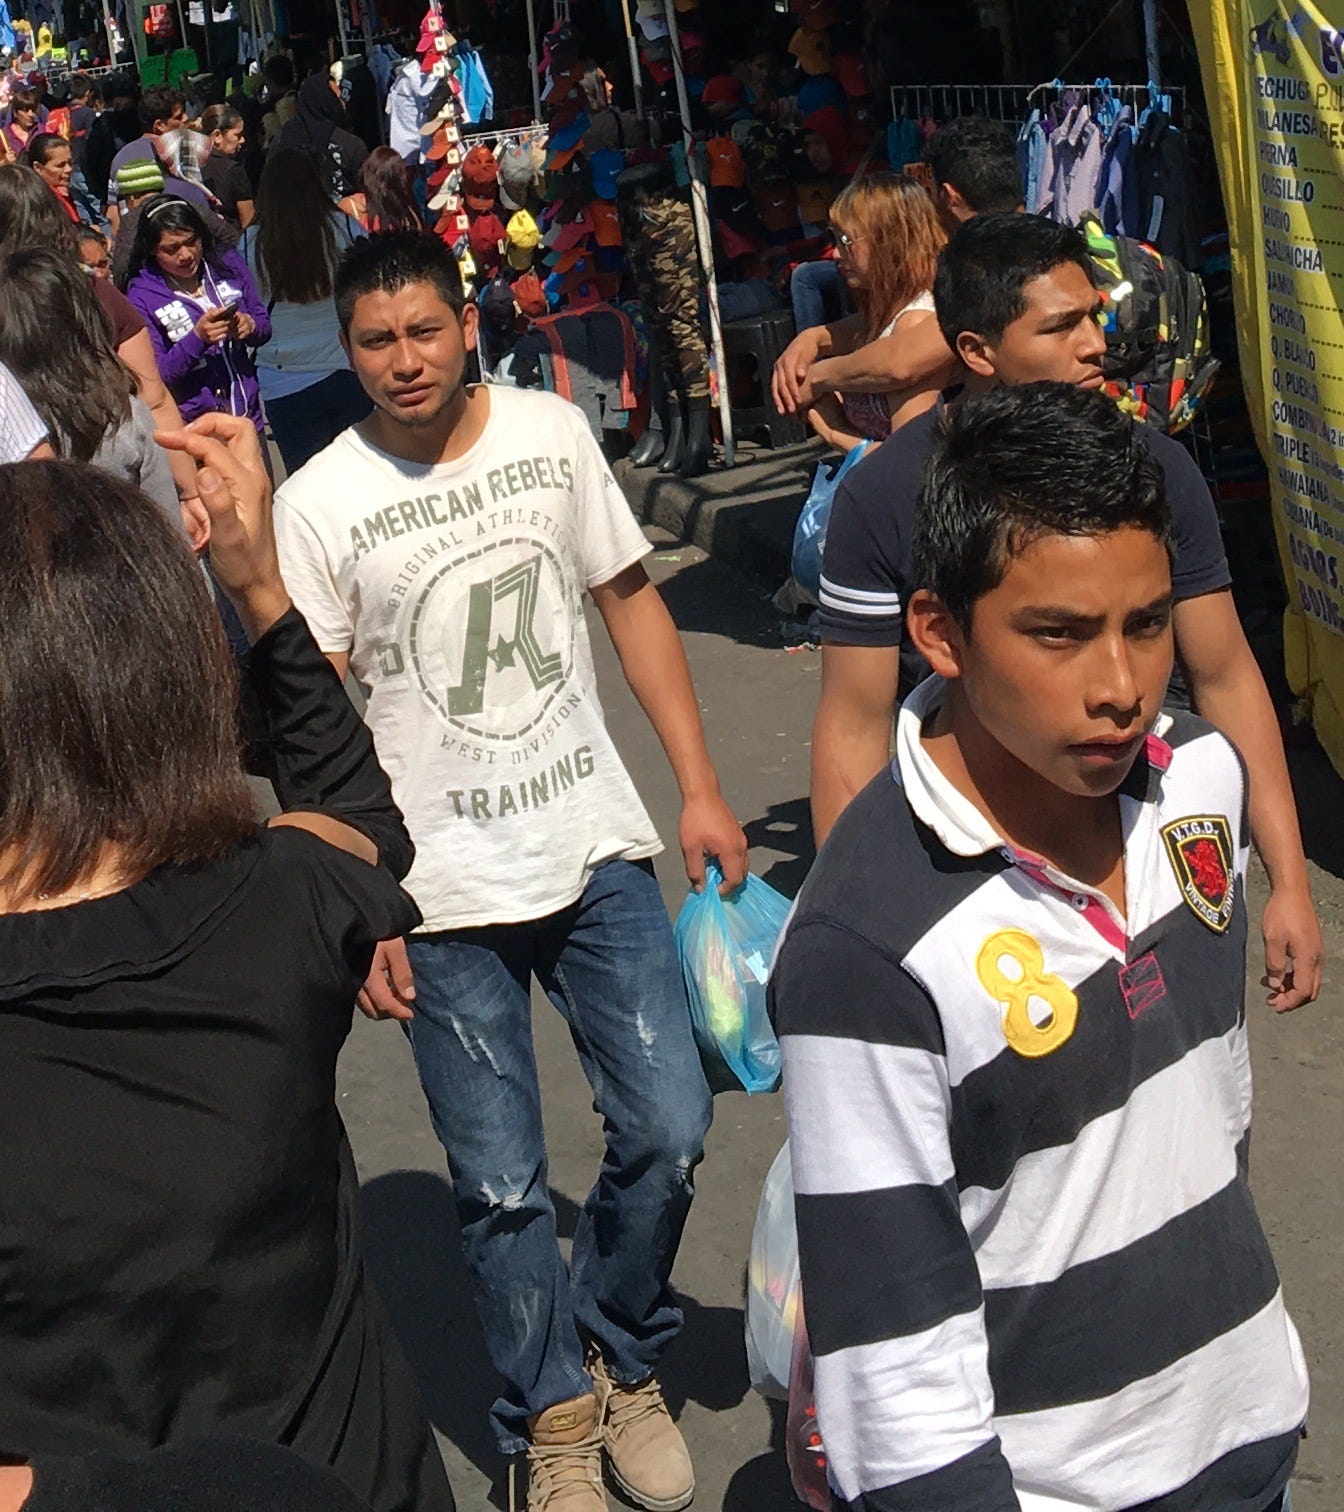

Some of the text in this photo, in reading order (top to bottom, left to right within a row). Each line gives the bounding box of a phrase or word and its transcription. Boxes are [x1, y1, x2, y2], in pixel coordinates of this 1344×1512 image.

[349, 455, 574, 561] AMERICAN REBELS
[388, 532, 464, 611] ORIGINAL
[440, 692, 582, 766] WEST DIVISION
[446, 744, 596, 821] TRAINING
[1184, 881, 1220, 924] VINTAGE
[975, 927, 1079, 1058] 8
